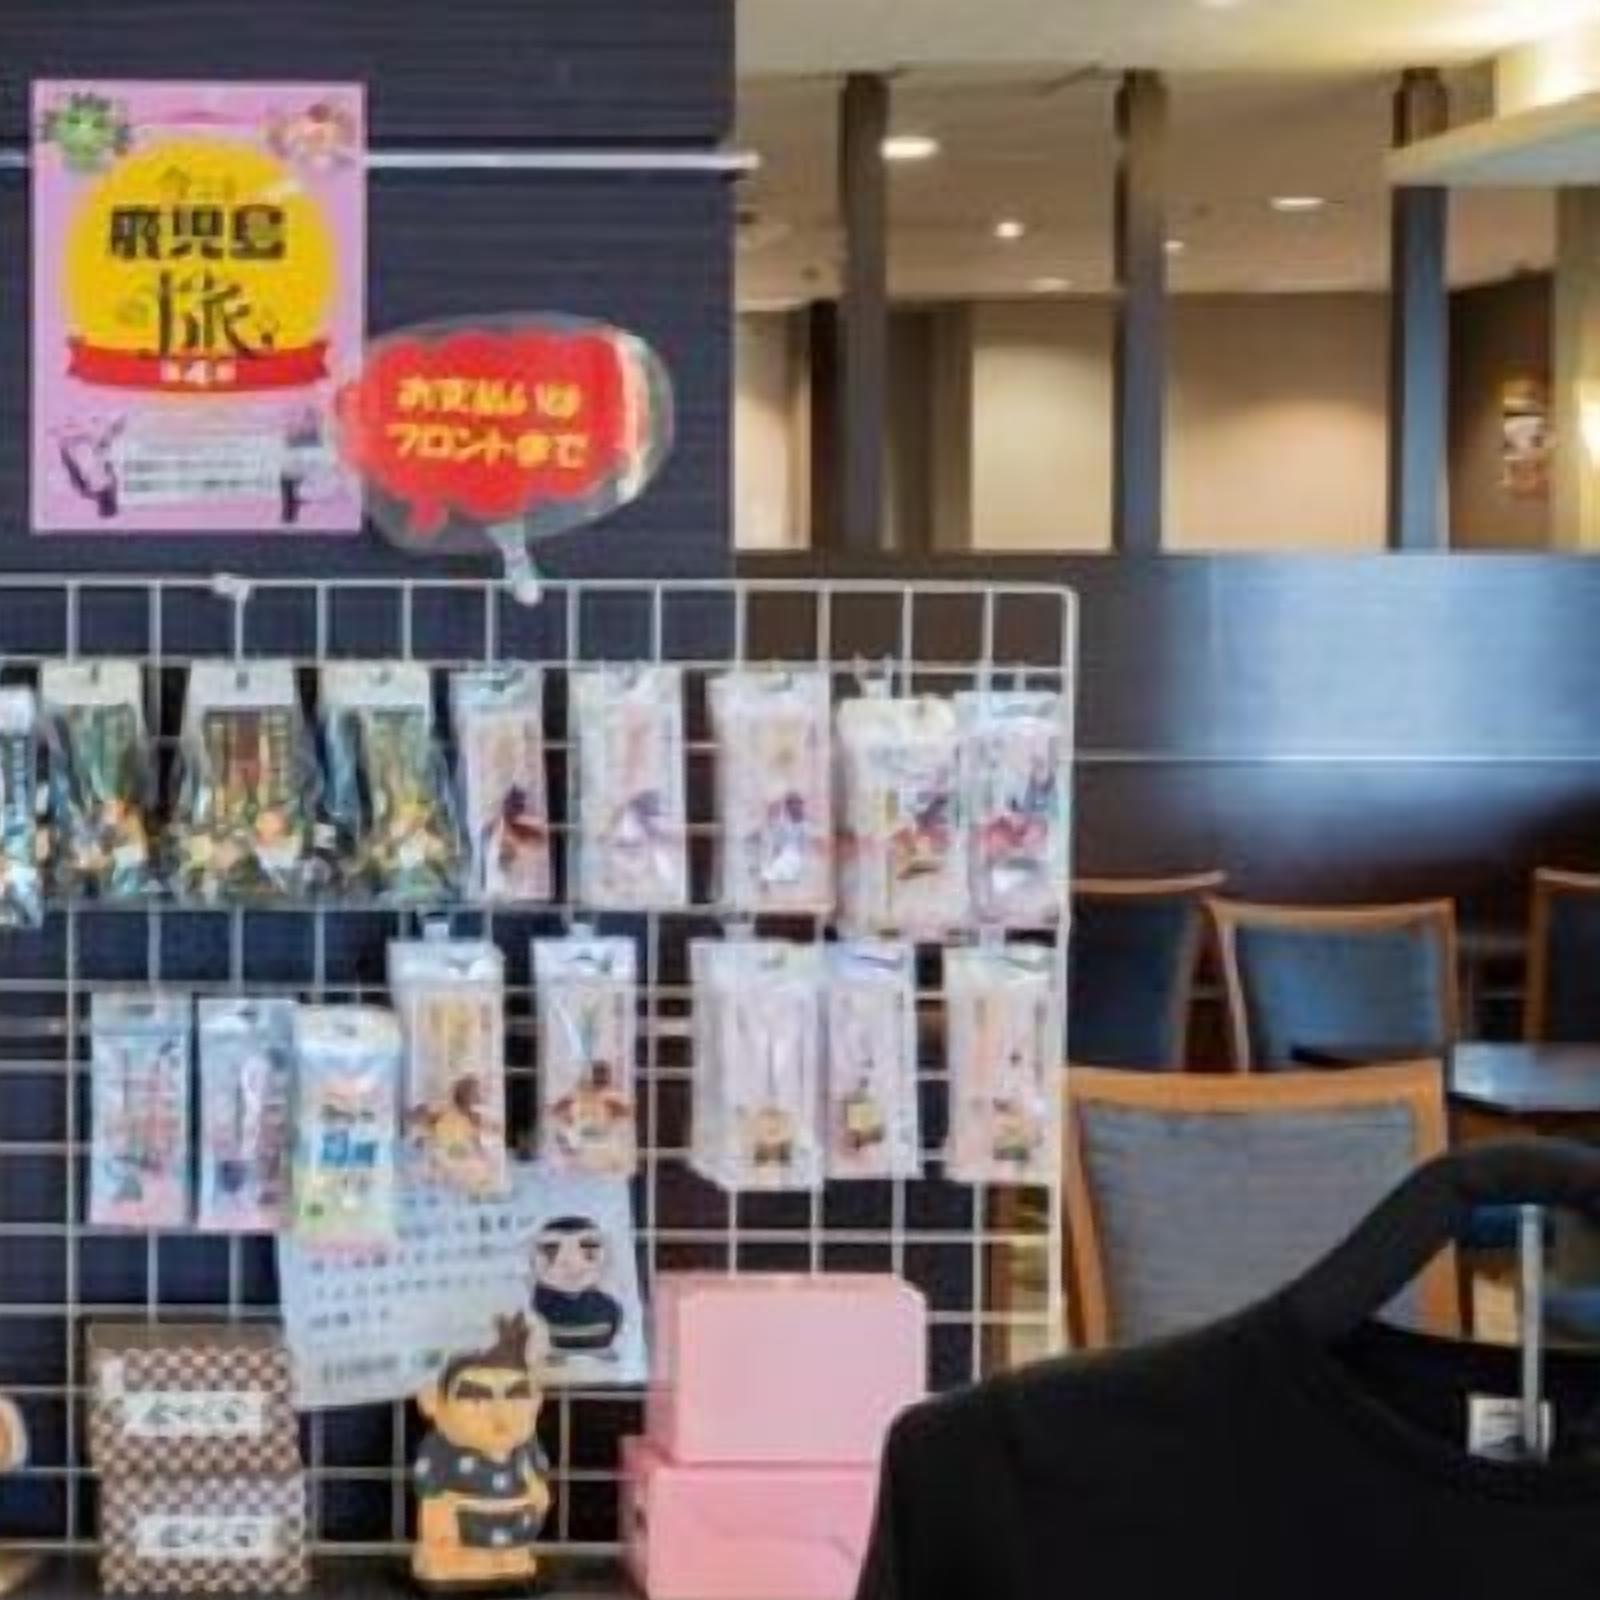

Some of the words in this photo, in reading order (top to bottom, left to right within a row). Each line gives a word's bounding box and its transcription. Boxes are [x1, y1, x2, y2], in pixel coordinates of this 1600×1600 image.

[397, 375, 582, 418] お支払いは
[384, 422, 590, 469] フロントまで
